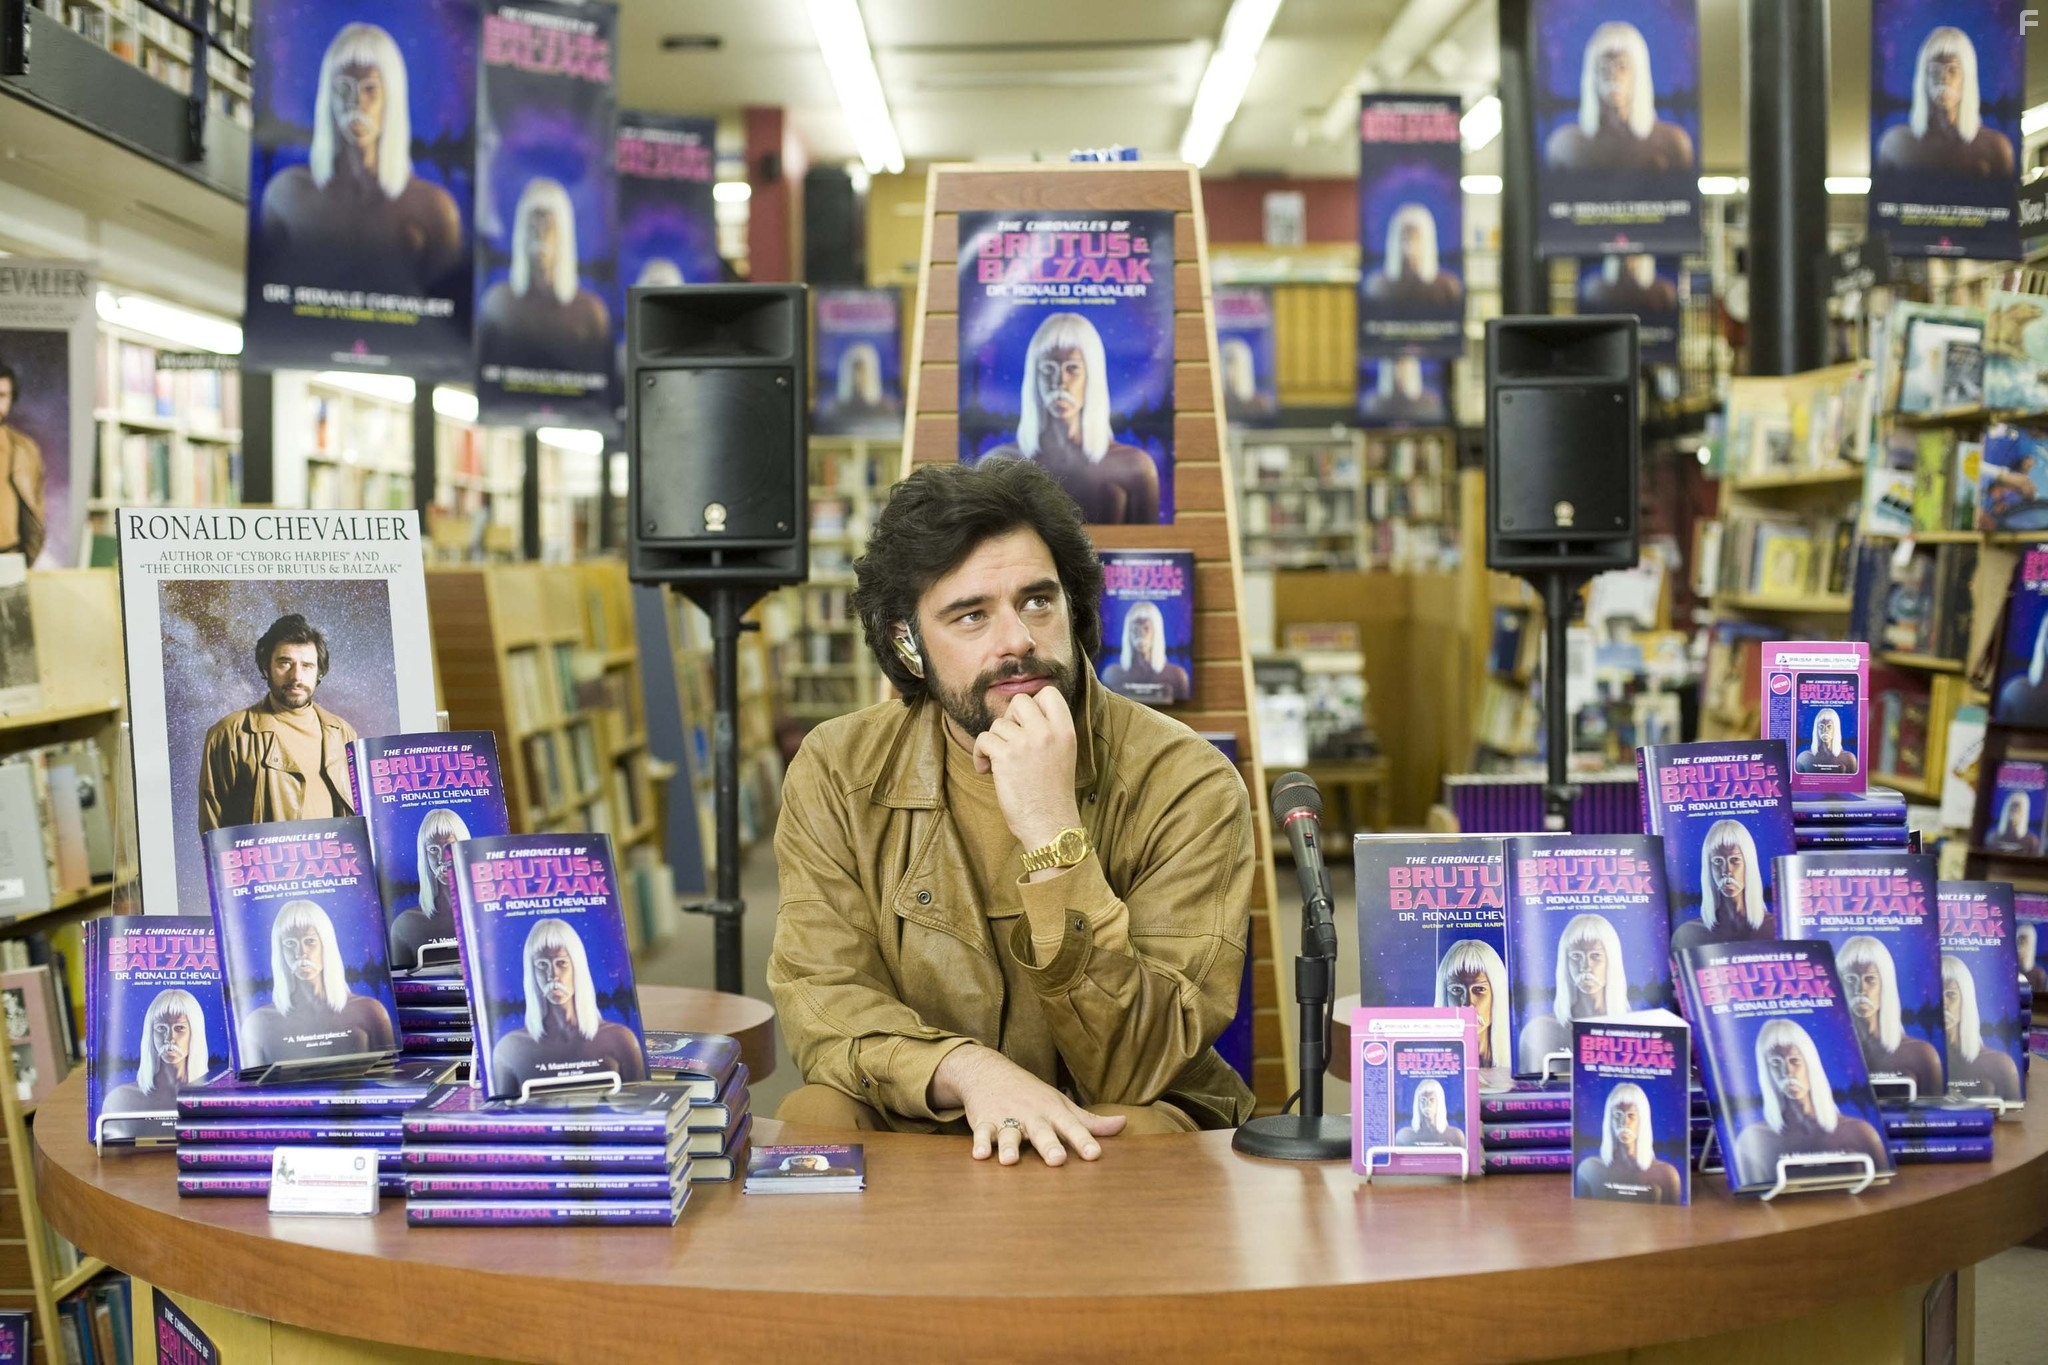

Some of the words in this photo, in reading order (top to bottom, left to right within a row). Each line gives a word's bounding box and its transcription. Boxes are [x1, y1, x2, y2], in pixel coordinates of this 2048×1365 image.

[997, 221, 1023, 231] THE
[1025, 221, 1107, 231] CHRONICLES
[1110, 221, 1130, 231] OF
[978, 232, 1131, 258] BRUTUS
[978, 259, 1153, 283] BALZAAK
[1013, 285, 1070, 296] RONALD
[1073, 285, 1146, 297] CHEVALIER
[129, 515, 247, 540] RONALD
[254, 516, 410, 541] CHEVALIER
[160, 551, 214, 562] AUTHOR
[216, 551, 234, 562] OF
[236, 551, 291, 562] “CYBORG
[294, 551, 350, 562] HARPIES”
[353, 551, 380, 562] AND
[140, 563, 171, 574] “THE
[173, 563, 255, 574] CHRONICLES
[257, 563, 275, 574] OF
[277, 563, 327, 574] BRUTUS
[329, 564, 340, 574] &
[343, 563, 402, 574] BALZAAK”
[1800, 683, 1849, 692] BRUTUS
[1799, 692, 1855, 700] BALZAAK
[383, 749, 402, 757] THE
[404, 745, 458, 755] CHRONICLES
[461, 744, 473, 752] OF
[370, 752, 475, 778] BRUTUS
[1673, 757, 1690, 765] THE
[1693, 755, 1749, 764] CHRONICLES
[1660, 762, 1766, 786] BRUTUS
[372, 770, 493, 795] BALZAAK
[382, 794, 398, 804] DR.
[401, 791, 440, 801] RONALD
[443, 788, 490, 798] CHEVALIER
[1662, 780, 1782, 803] BALZAAK
[1669, 804, 1685, 812] DR.
[1688, 801, 1727, 811] RONALD
[1730, 799, 1778, 808] CHEVALIER
[235, 840, 255, 848] THE
[258, 833, 322, 845] CHRONICLES
[222, 840, 341, 869] BRUTUS
[486, 851, 506, 859] THE
[509, 848, 571, 857] CHRONICLES
[574, 847, 587, 855] OF
[1405, 856, 1427, 864] THE
[1431, 855, 1502, 864] CHRONICLES
[1554, 849, 1617, 857] CHRONICLES
[224, 857, 362, 888] BALZAAK
[471, 856, 591, 883] BRUTUS
[1518, 857, 1636, 878] BRUTUS
[1806, 869, 1825, 877] THE
[1828, 869, 1891, 877] CHRONICLES
[1893, 869, 1908, 877] OF
[233, 886, 251, 897] DR.
[254, 882, 298, 894] RONALD
[302, 878, 357, 889] CHEVALIER
[473, 876, 610, 903] BALZAAK
[1519, 876, 1655, 896] BALZAAK
[1798, 877, 1910, 897] BRUTUS
[484, 902, 502, 912] DR.
[505, 899, 550, 910] RONALD
[553, 896, 606, 906] CHEVALIER
[1390, 888, 1504, 910] BALZA
[1525, 896, 1543, 905] DR.
[1546, 895, 1590, 904] RONALD
[1593, 895, 1649, 904] CHEVALIER
[1799, 896, 1927, 916] BALZAAK
[1399, 912, 1418, 921] DR.
[1423, 911, 1471, 921] RONALD
[1800, 917, 1818, 926] DR.
[1820, 916, 1864, 925] RONALD
[1867, 916, 1923, 925] CHEVALIER
[123, 928, 142, 936] THE
[145, 928, 205, 936] CHRONICLES
[1948, 937, 2001, 946] CHEVALIER
[1710, 957, 1729, 965] THE
[1731, 954, 1793, 964] CHRONICLES
[1794, 953, 1808, 961] OF
[115, 971, 131, 980] DR.
[135, 971, 177, 980] RONALD
[1696, 961, 1814, 987] BRUTUS
[1701, 980, 1836, 1006] BALZAAK
[1712, 1005, 1731, 1015] DR.
[1734, 1001, 1778, 1012] RONALD
[1779, 998, 1833, 1008] CHEVALIER
[1581, 1050, 1676, 1069] BALZAAK
[200, 1130, 249, 1140] BRUTUS
[256, 1130, 311, 1139] BALZAAK
[164, 1307, 174, 1324] THE
[174, 1317, 203, 1353] CHRONICLES
